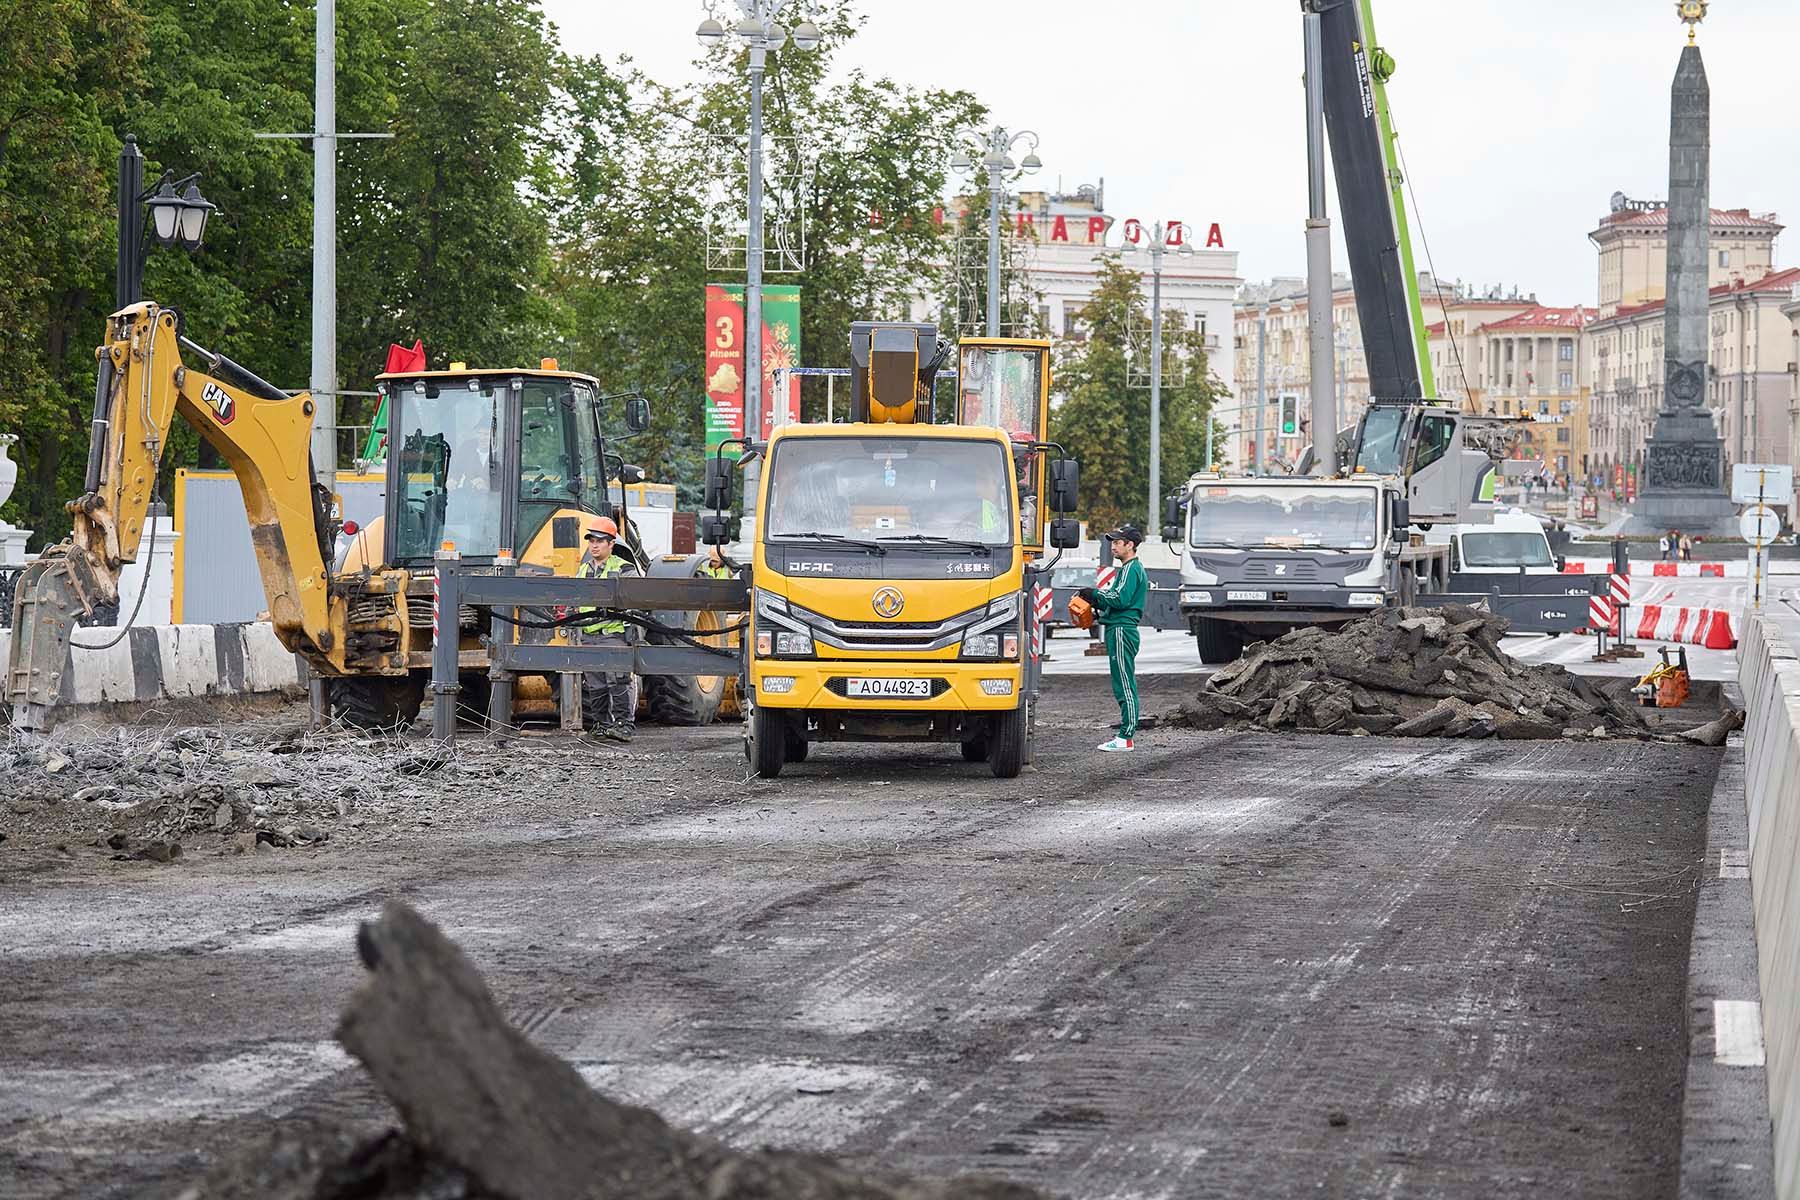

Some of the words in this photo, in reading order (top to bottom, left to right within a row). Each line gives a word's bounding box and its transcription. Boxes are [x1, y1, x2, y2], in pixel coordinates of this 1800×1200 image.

[1016, 211, 1224, 248] НАРОДА
[716, 316, 734, 349] 3
[202, 382, 233, 417] CAT
[789, 562, 834, 572] DFAC
